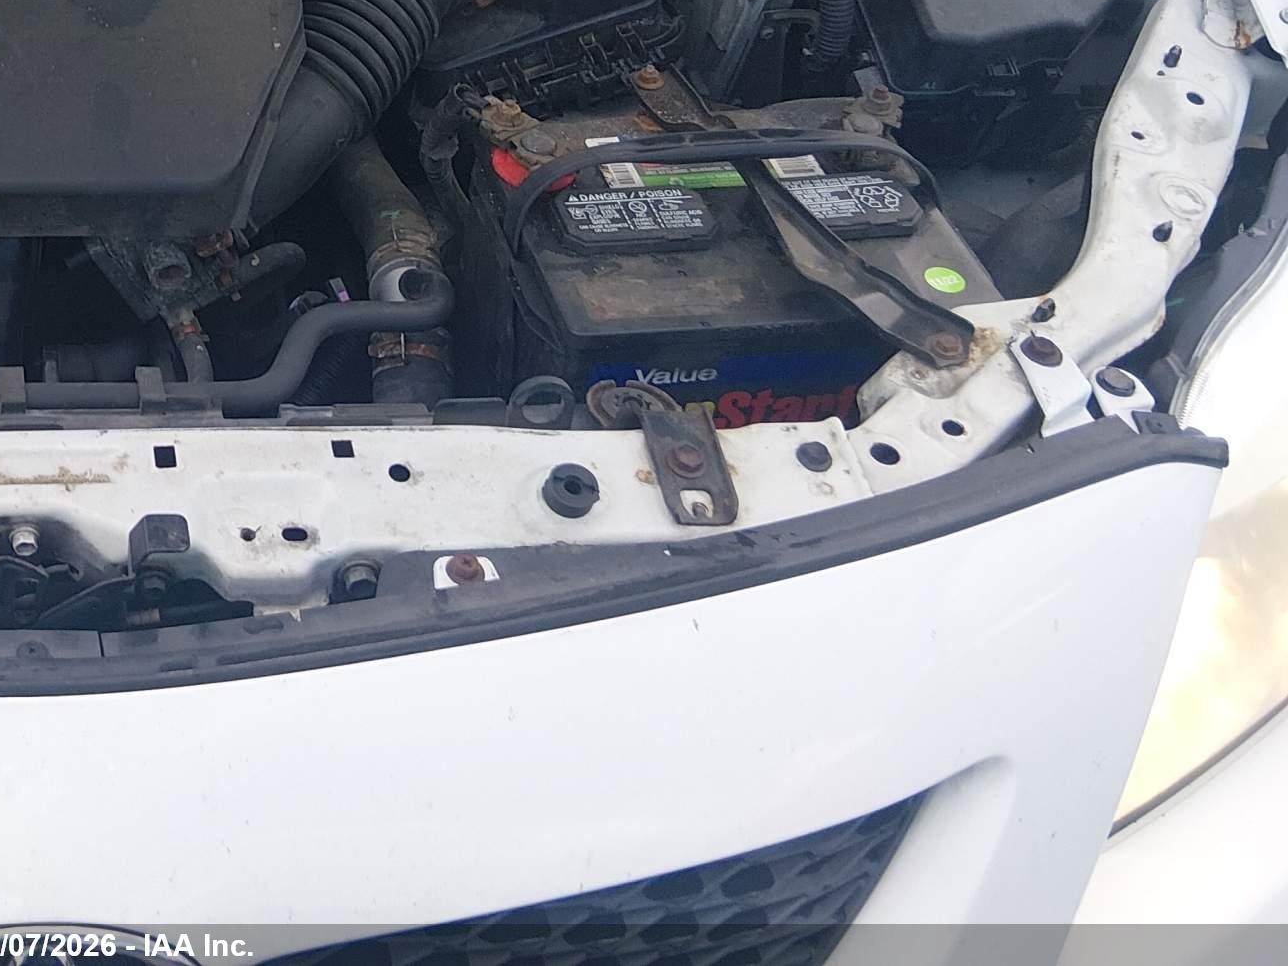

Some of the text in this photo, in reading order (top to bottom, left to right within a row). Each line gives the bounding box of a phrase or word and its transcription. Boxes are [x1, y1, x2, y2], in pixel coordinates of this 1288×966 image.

[579, 188, 682, 202] DANGER / POISON
[635, 367, 718, 384] Value
